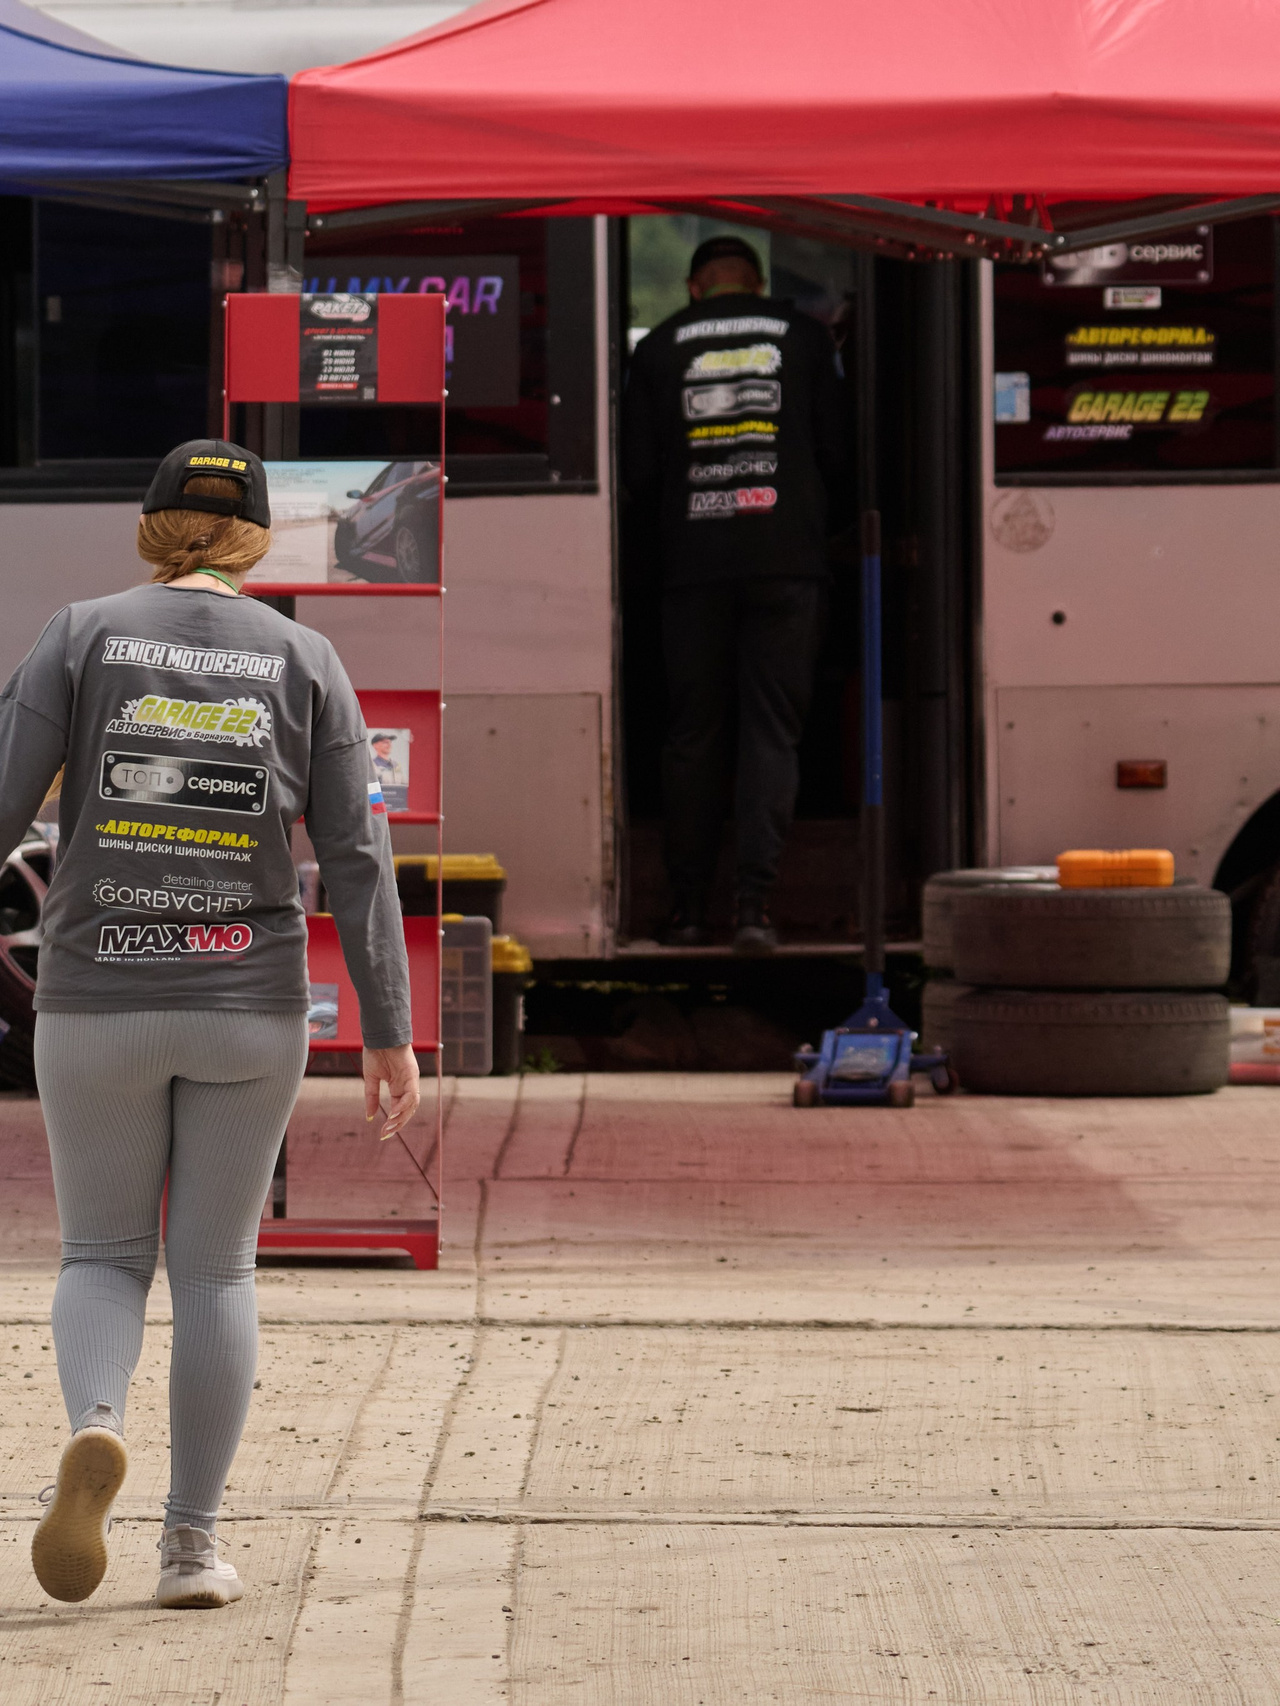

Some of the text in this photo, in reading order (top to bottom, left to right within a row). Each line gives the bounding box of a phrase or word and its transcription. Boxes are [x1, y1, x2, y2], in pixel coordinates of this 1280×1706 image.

[1130, 244, 1204, 264] сервис
[714, 318, 788, 335] MOTORSPORT
[1068, 391, 1210, 423] GARAGE 22
[1044, 425, 1133, 440] АВТОСЕРВИС
[189, 456, 247, 471] GARAGE 22
[104, 638, 284, 680] ZENICH MOTORSPORT
[134, 697, 258, 735] GARAGE 22
[106, 720, 186, 739] АВТОСЕРВИС
[193, 730, 235, 743] Барнауле
[122, 768, 257, 796] ТОП сервис
[95, 819, 259, 848] «АВТОРЕФОРМА»
[98, 837, 252, 862] ШИНЫ ДИСКИ ШИНОМОНТАЖ
[162, 873, 253, 891] detailing center
[97, 923, 253, 955] MAXMO
